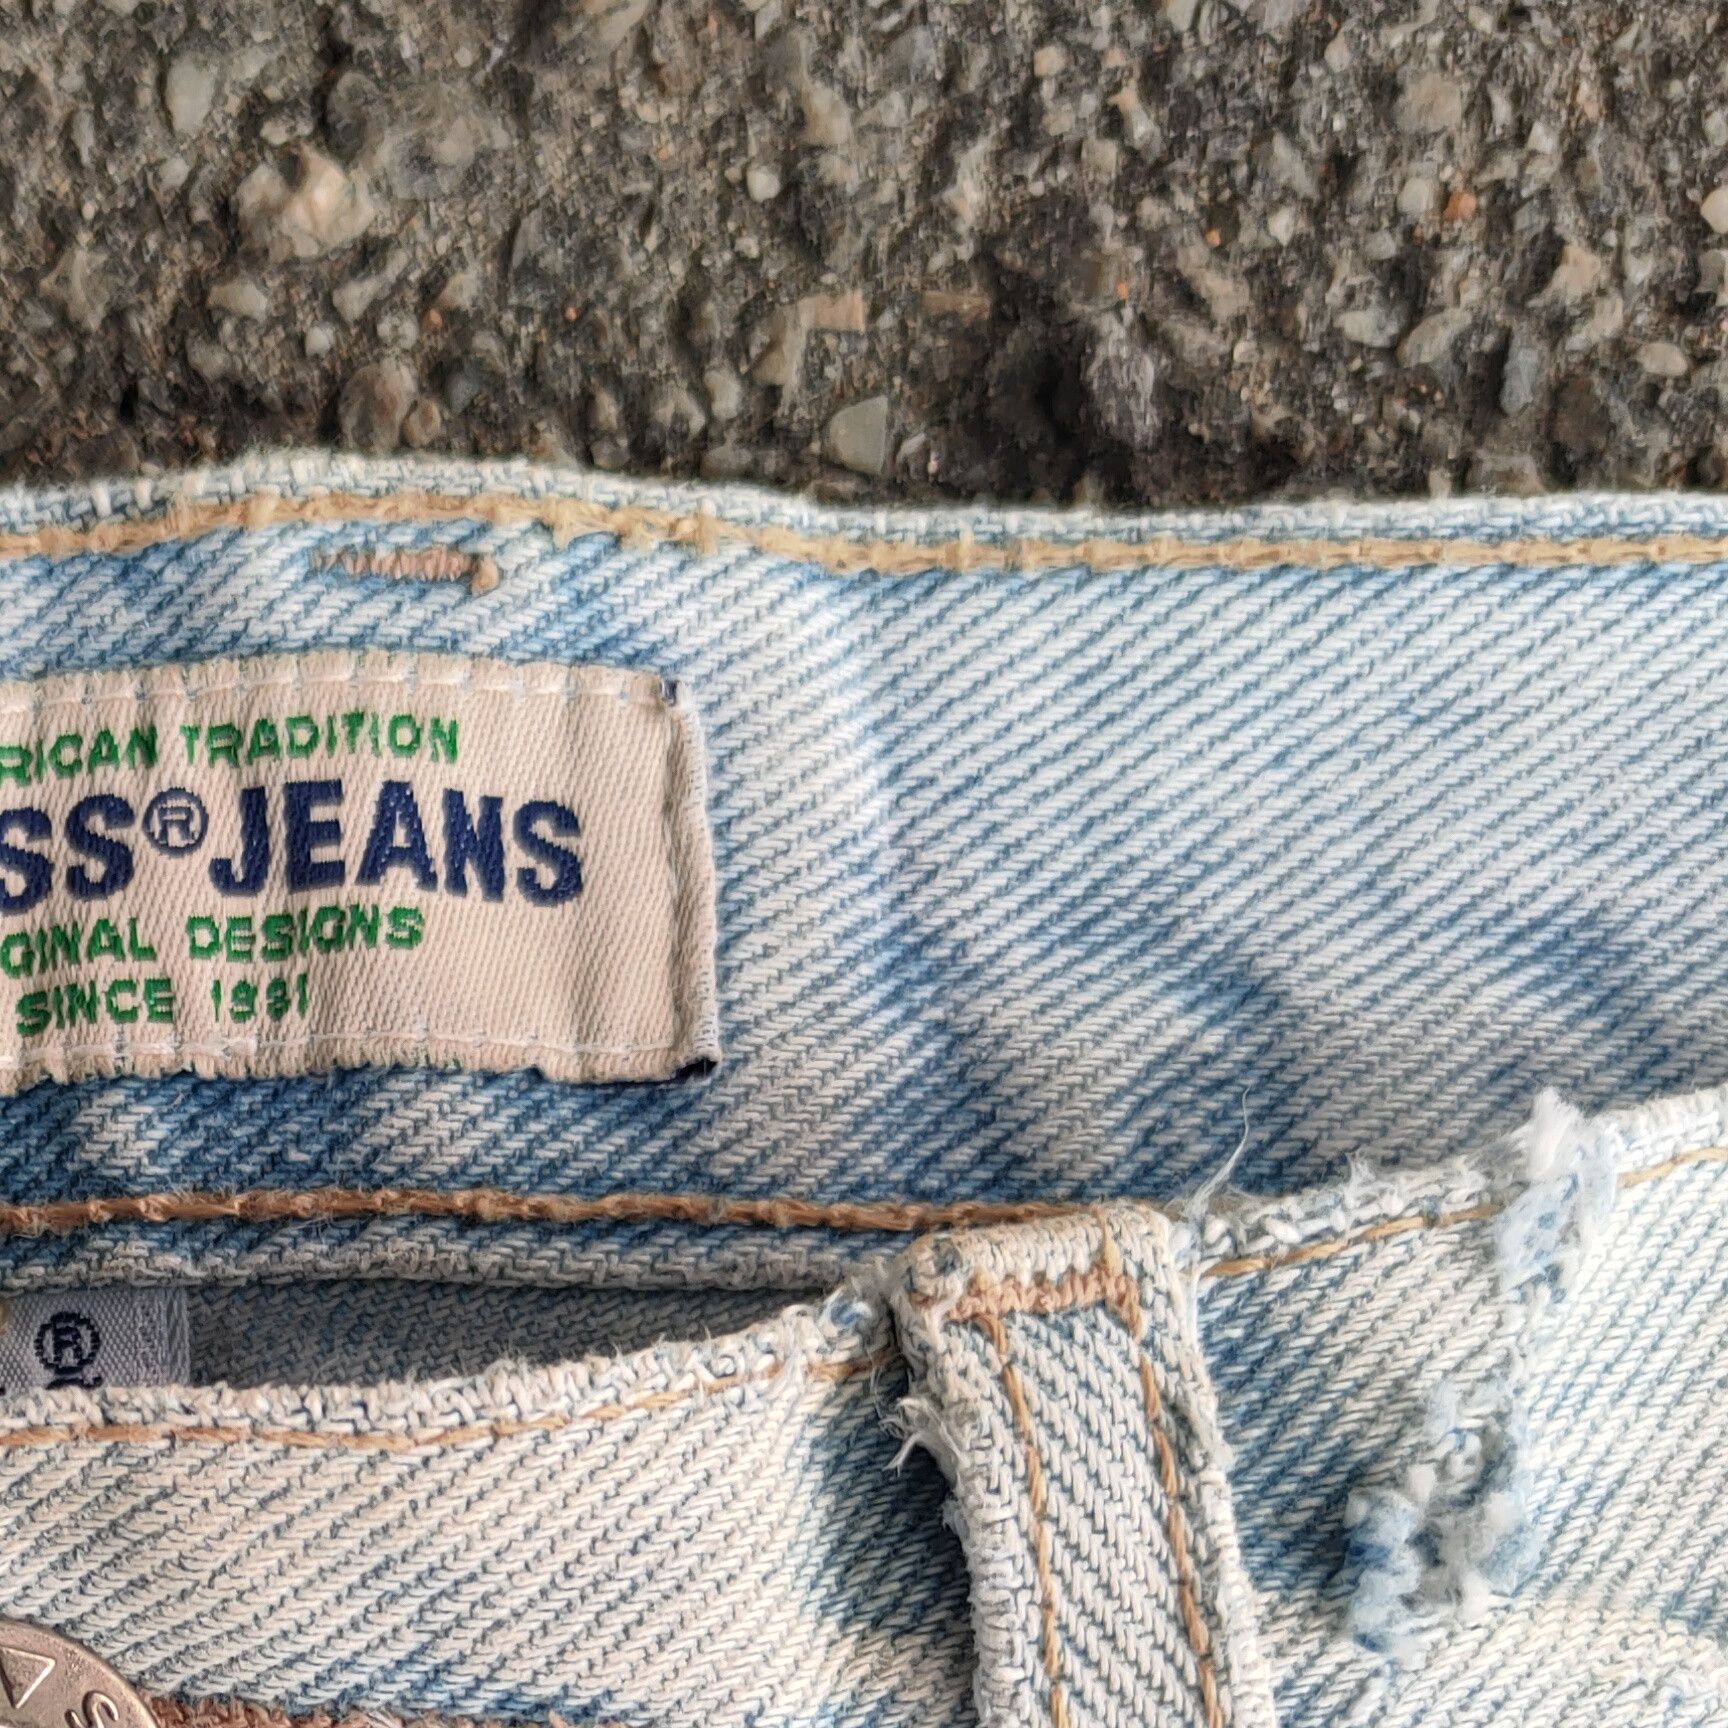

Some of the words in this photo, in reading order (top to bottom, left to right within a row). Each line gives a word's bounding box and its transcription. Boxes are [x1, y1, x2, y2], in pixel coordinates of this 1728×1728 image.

[180, 708, 459, 770] TRADITION
[184, 903, 425, 964] DESIGNS
[15, 976, 174, 1037] SINCE
